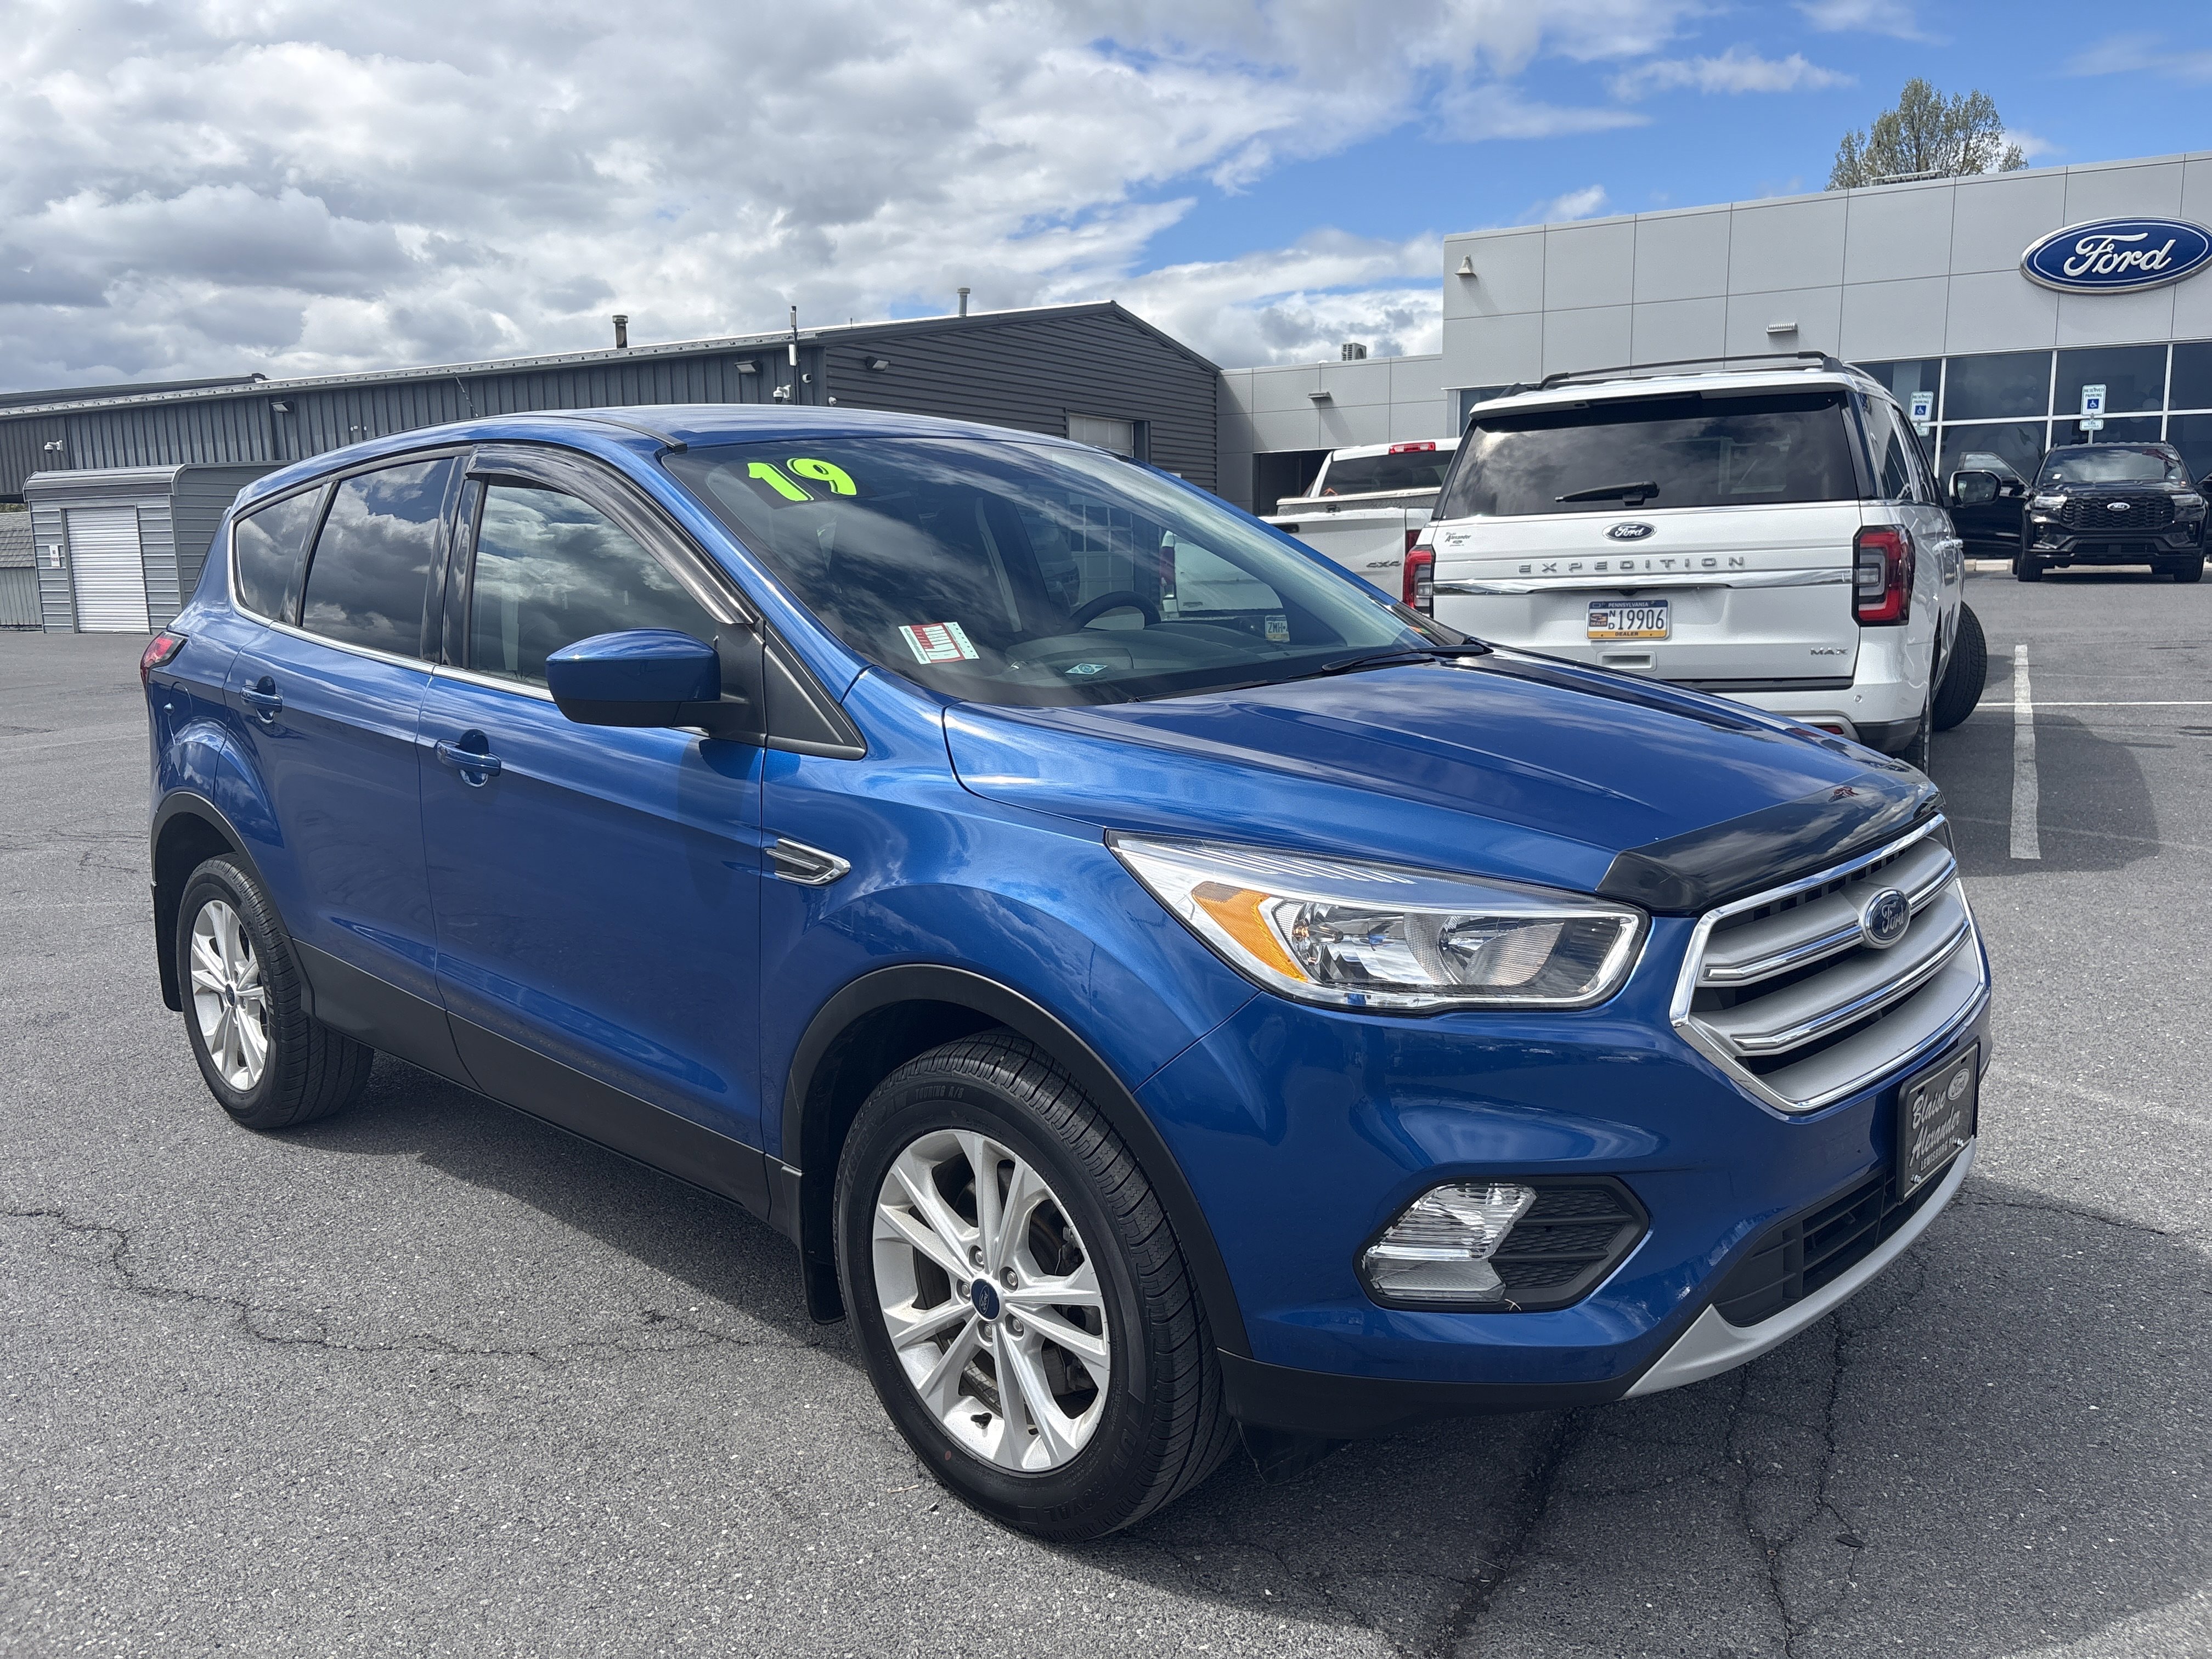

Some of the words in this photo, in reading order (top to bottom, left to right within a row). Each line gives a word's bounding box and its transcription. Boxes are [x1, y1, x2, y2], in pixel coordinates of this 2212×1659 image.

[2063, 232, 2176, 276] Ford
[747, 457, 857, 501] 19
[1615, 525, 1644, 537] Ford
[1519, 557, 1744, 574] EXPEDITION
[1618, 609, 1664, 630] 19906
[1881, 901, 1904, 933] Ford
[915, 1085, 945, 1101] TOURING
[948, 1086, 965, 1099] A/S
[1951, 1074, 1966, 1096] Ford
[1912, 1090, 1946, 1130] Blaise
[1909, 1105, 1961, 1167] Alexander
[1920, 1139, 1948, 1171] LEWISBURG
